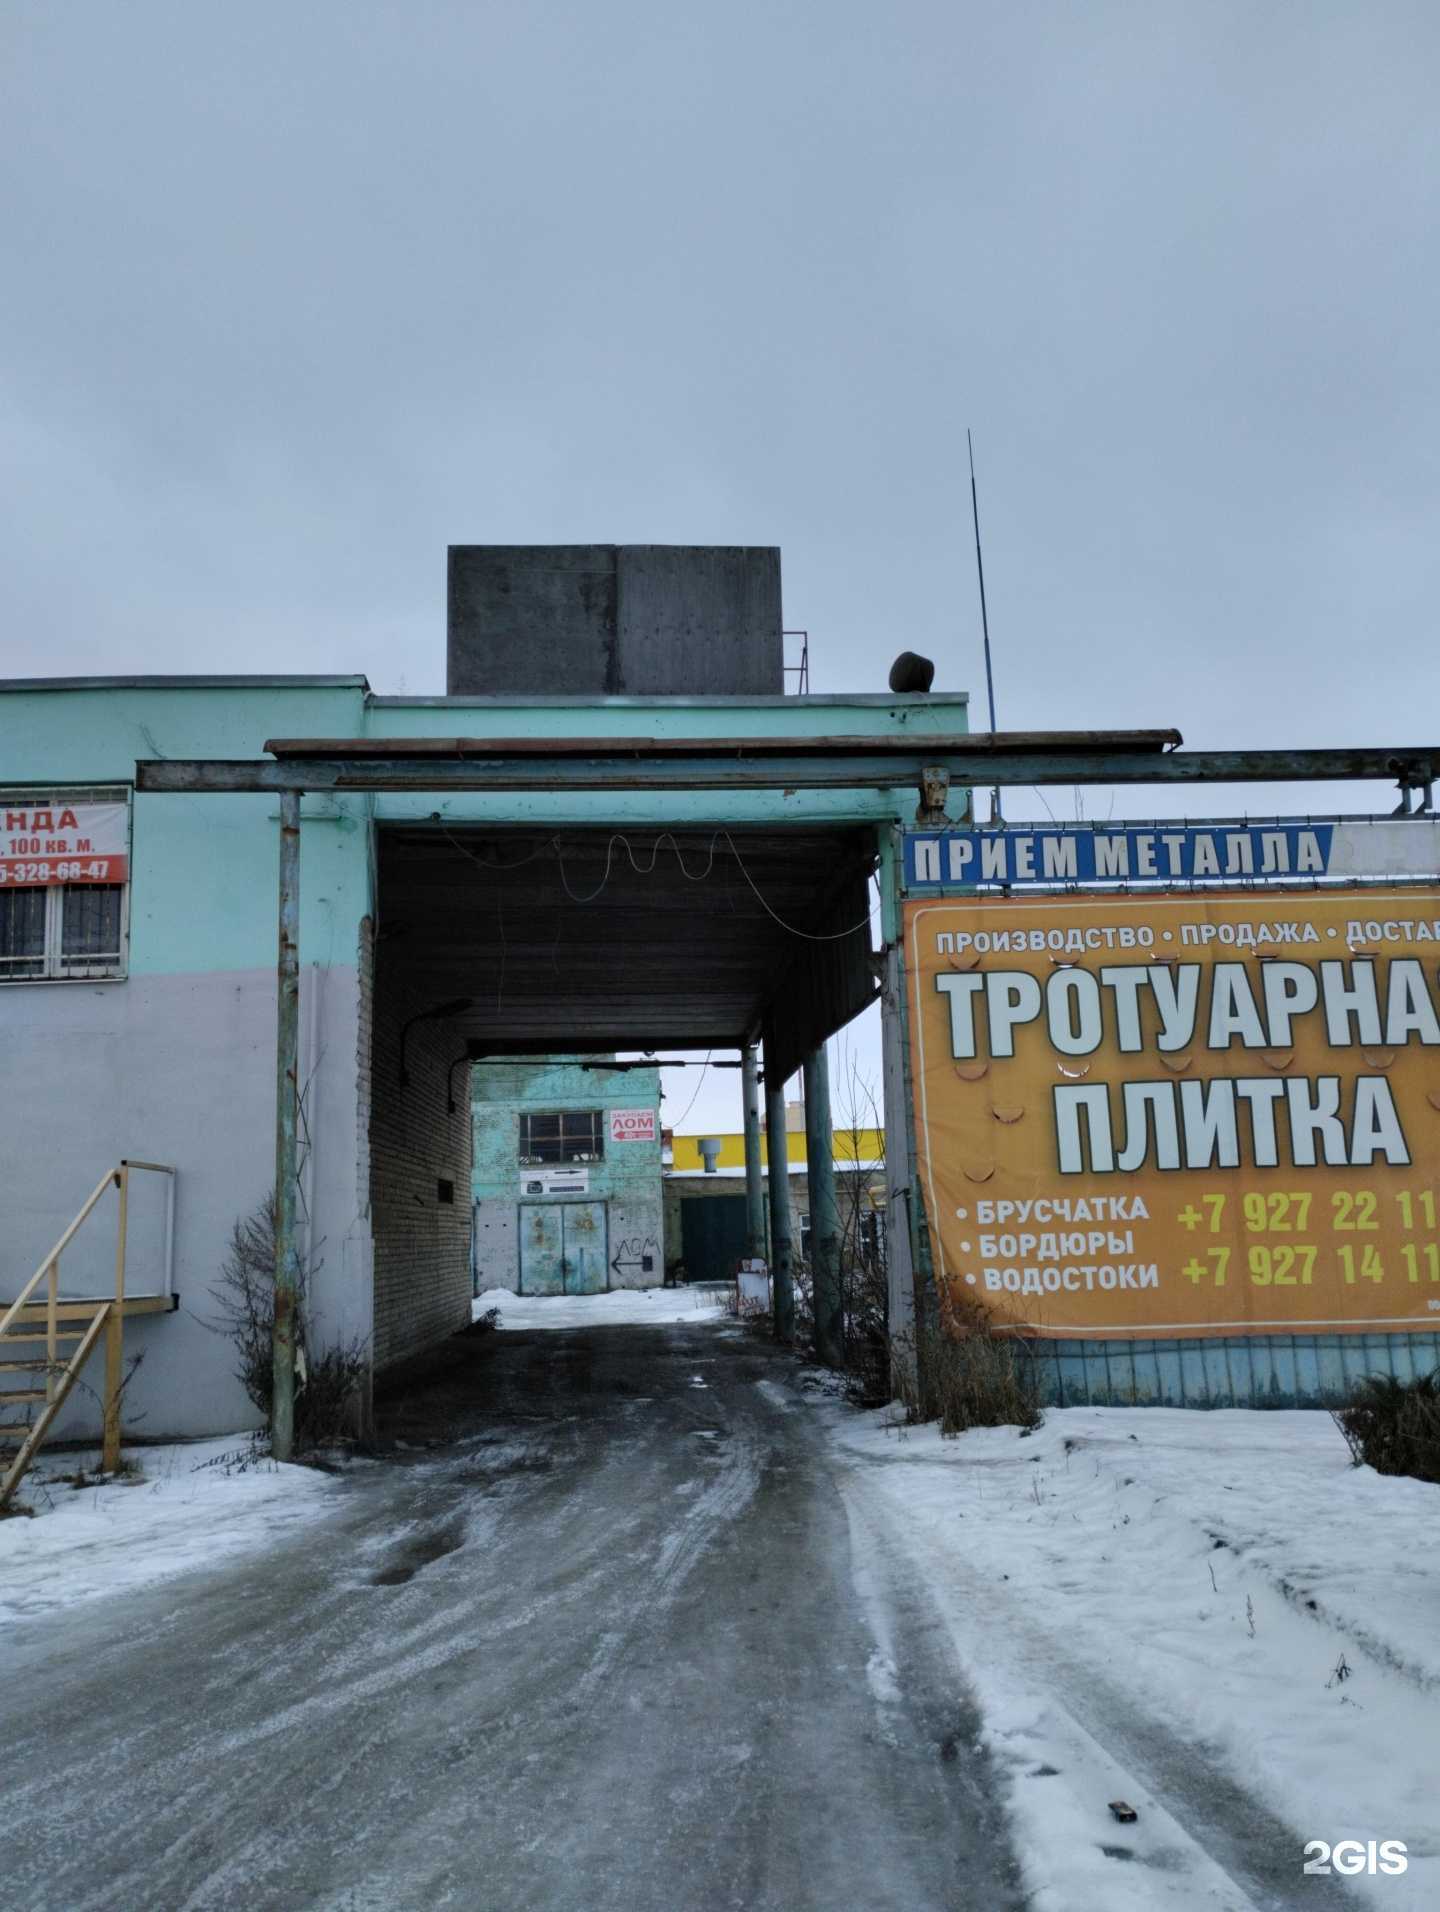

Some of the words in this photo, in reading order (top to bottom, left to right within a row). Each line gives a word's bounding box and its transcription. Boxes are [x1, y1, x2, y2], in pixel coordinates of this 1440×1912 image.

[0, 810, 79, 834] НДА
[9, 838, 41, 855] 100
[914, 836, 1078, 882] ПРИЕМ
[1097, 831, 1326, 877] МЕТАЛЛА
[937, 926, 1154, 954] ПРОИЗВОДСТВО
[1181, 922, 1320, 948] ПРОДАЖА
[935, 958, 1440, 1060] ТРОТУАРНА
[612, 1118, 653, 1129] ЛОМ
[1052, 1075, 1412, 1175] ПЛИТКА
[976, 1196, 1150, 1225] БРУСЧАТКА
[1177, 1194, 1226, 1233] +7
[1244, 1192, 1311, 1232] 927
[1332, 1191, 1380, 1231] 22
[1396, 1190, 1436, 1229] 11
[979, 1231, 1135, 1261] БОРДЮРЫ
[984, 1265, 1160, 1295] ВОДОСТОКИ
[1183, 1247, 1232, 1287] +7
[1249, 1246, 1318, 1285] 927
[1337, 1245, 1385, 1283] 14
[1400, 1243, 1440, 1282] 11
